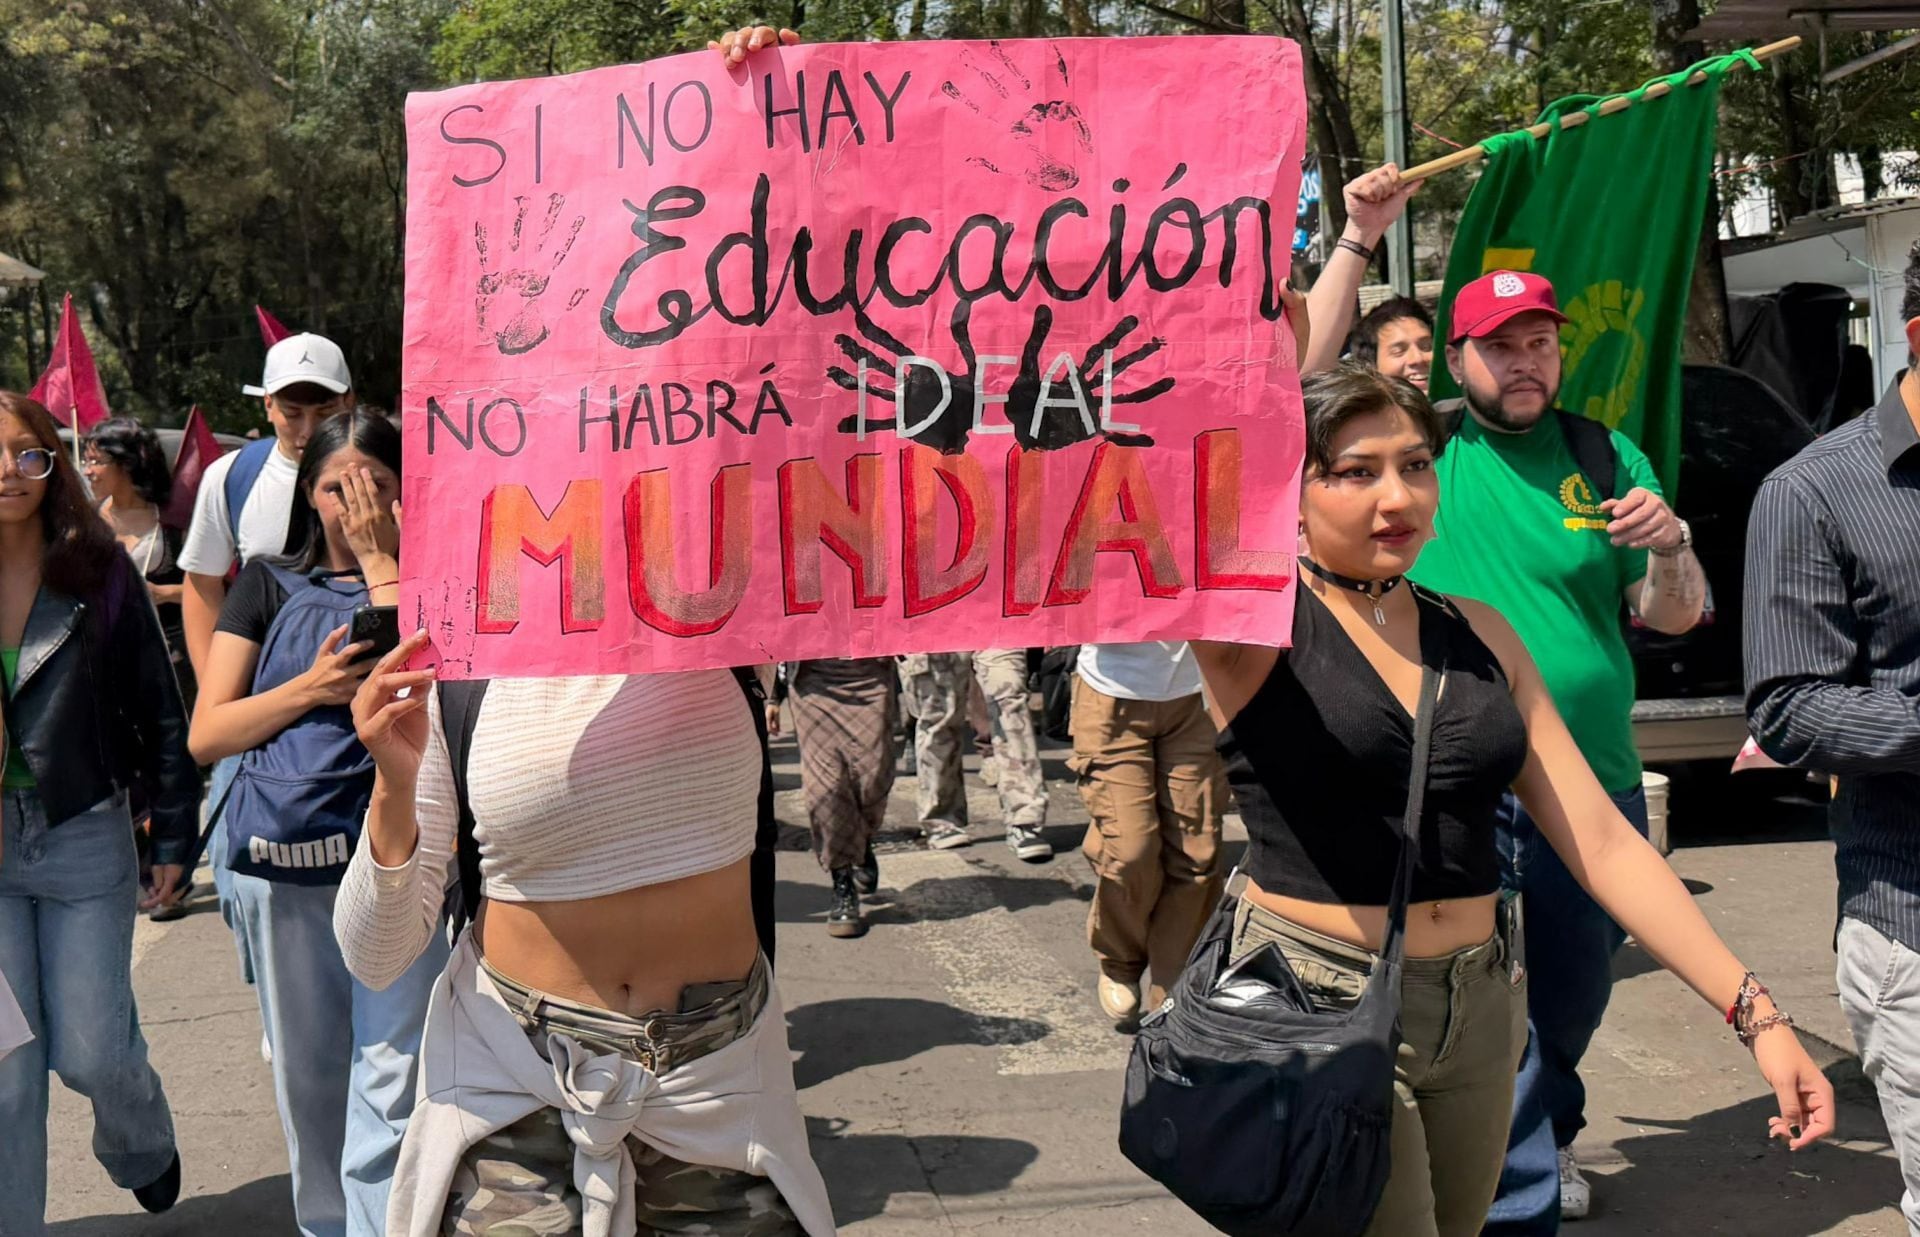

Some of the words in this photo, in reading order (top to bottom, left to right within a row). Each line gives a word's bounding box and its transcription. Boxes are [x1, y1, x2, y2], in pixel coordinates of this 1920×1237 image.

[440, 104, 542, 188] SI
[617, 80, 713, 168] NO
[764, 69, 911, 154] HAY
[599, 162, 1282, 349] Educación
[427, 396, 527, 457] NO
[579, 362, 793, 452] HABRÁ
[856, 348, 1141, 441] IDEAL
[475, 428, 1291, 637] MUNDIAL
[249, 832, 349, 868] PUMA
